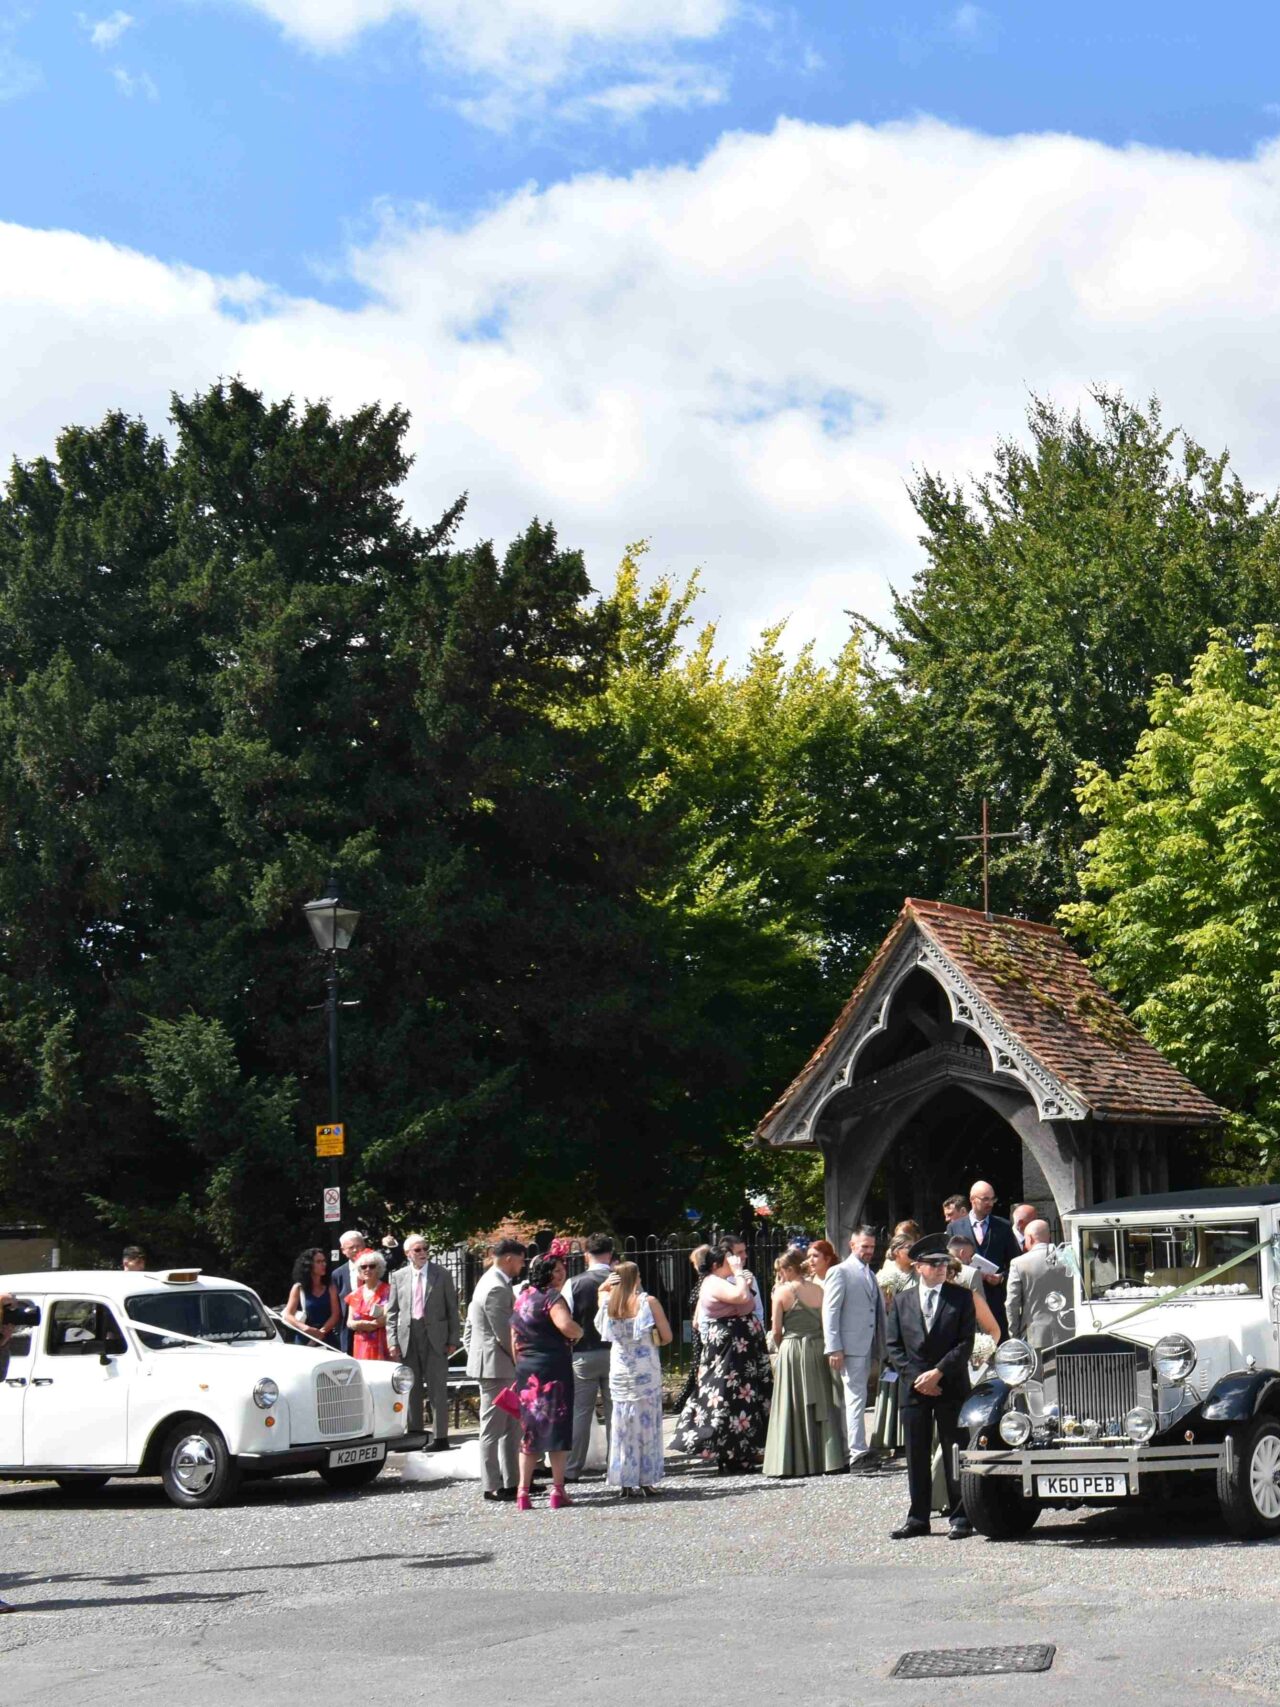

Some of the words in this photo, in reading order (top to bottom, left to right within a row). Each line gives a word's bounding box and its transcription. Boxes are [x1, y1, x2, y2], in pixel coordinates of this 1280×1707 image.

[337, 1450, 357, 1465] K20
[359, 1446, 378, 1461] PEB
[1048, 1477, 1079, 1494] K60
[1083, 1476, 1115, 1493] PEB
